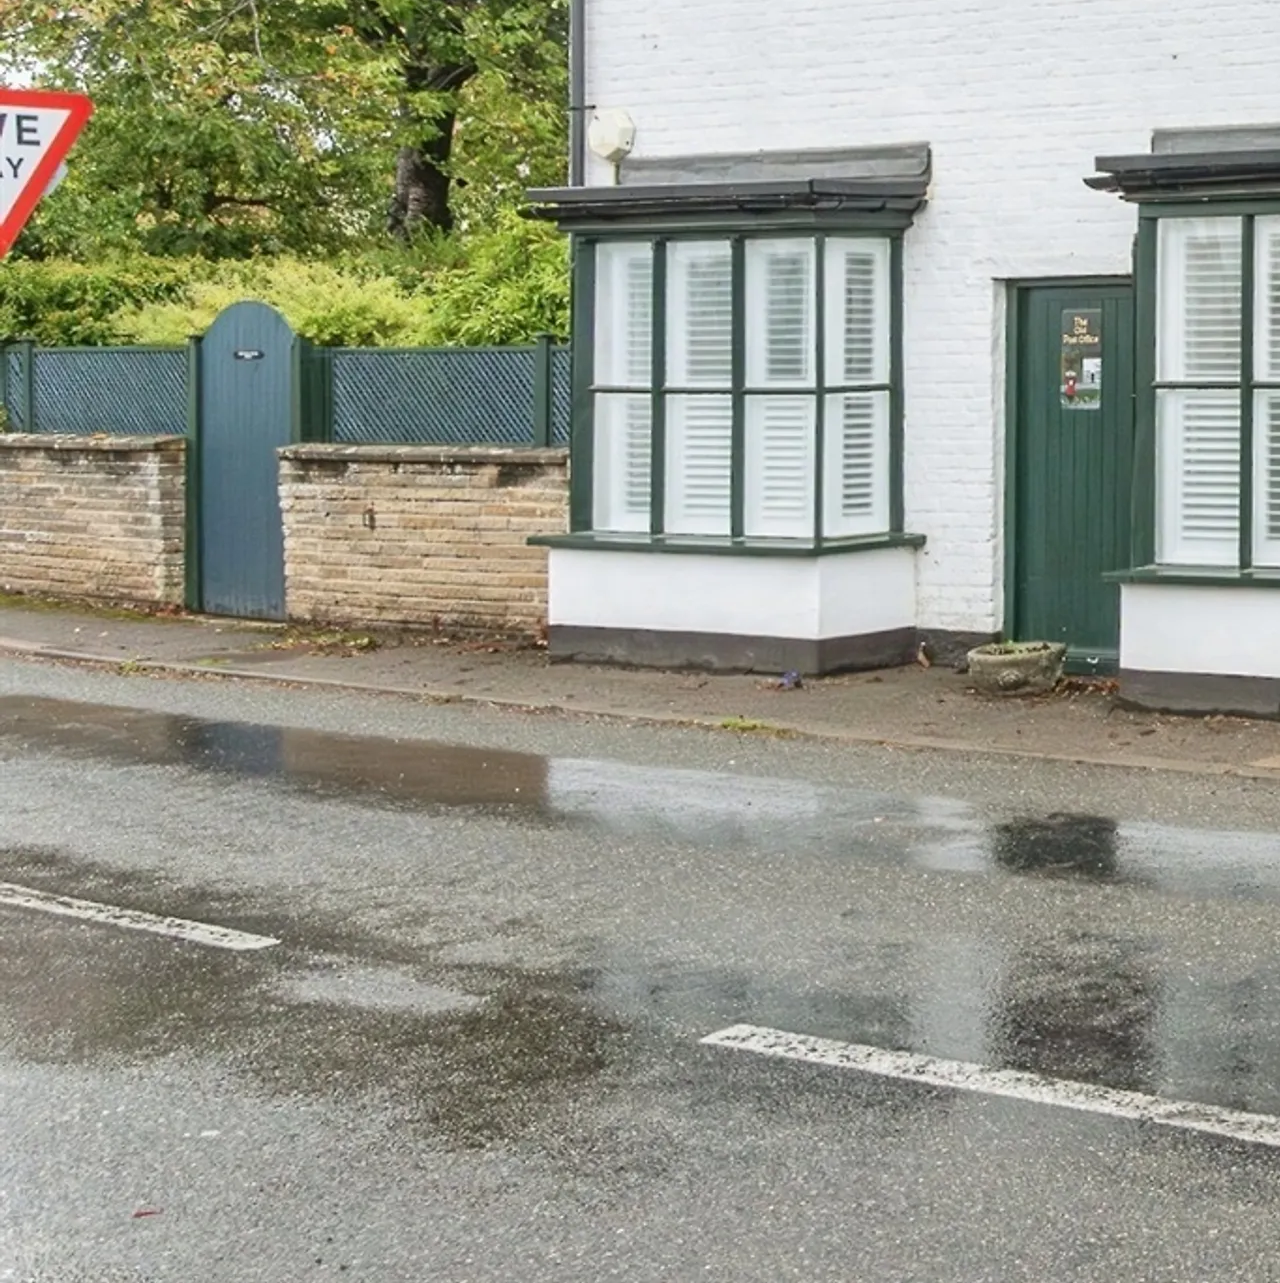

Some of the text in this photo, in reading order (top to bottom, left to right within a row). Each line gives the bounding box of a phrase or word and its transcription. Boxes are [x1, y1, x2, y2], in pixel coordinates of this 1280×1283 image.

[0, 113, 41, 147] E
[0, 157, 24, 178] Y
[1074, 316, 1088, 326] The
[1073, 326, 1087, 335] Old
[1063, 334, 1099, 344] Post Office
